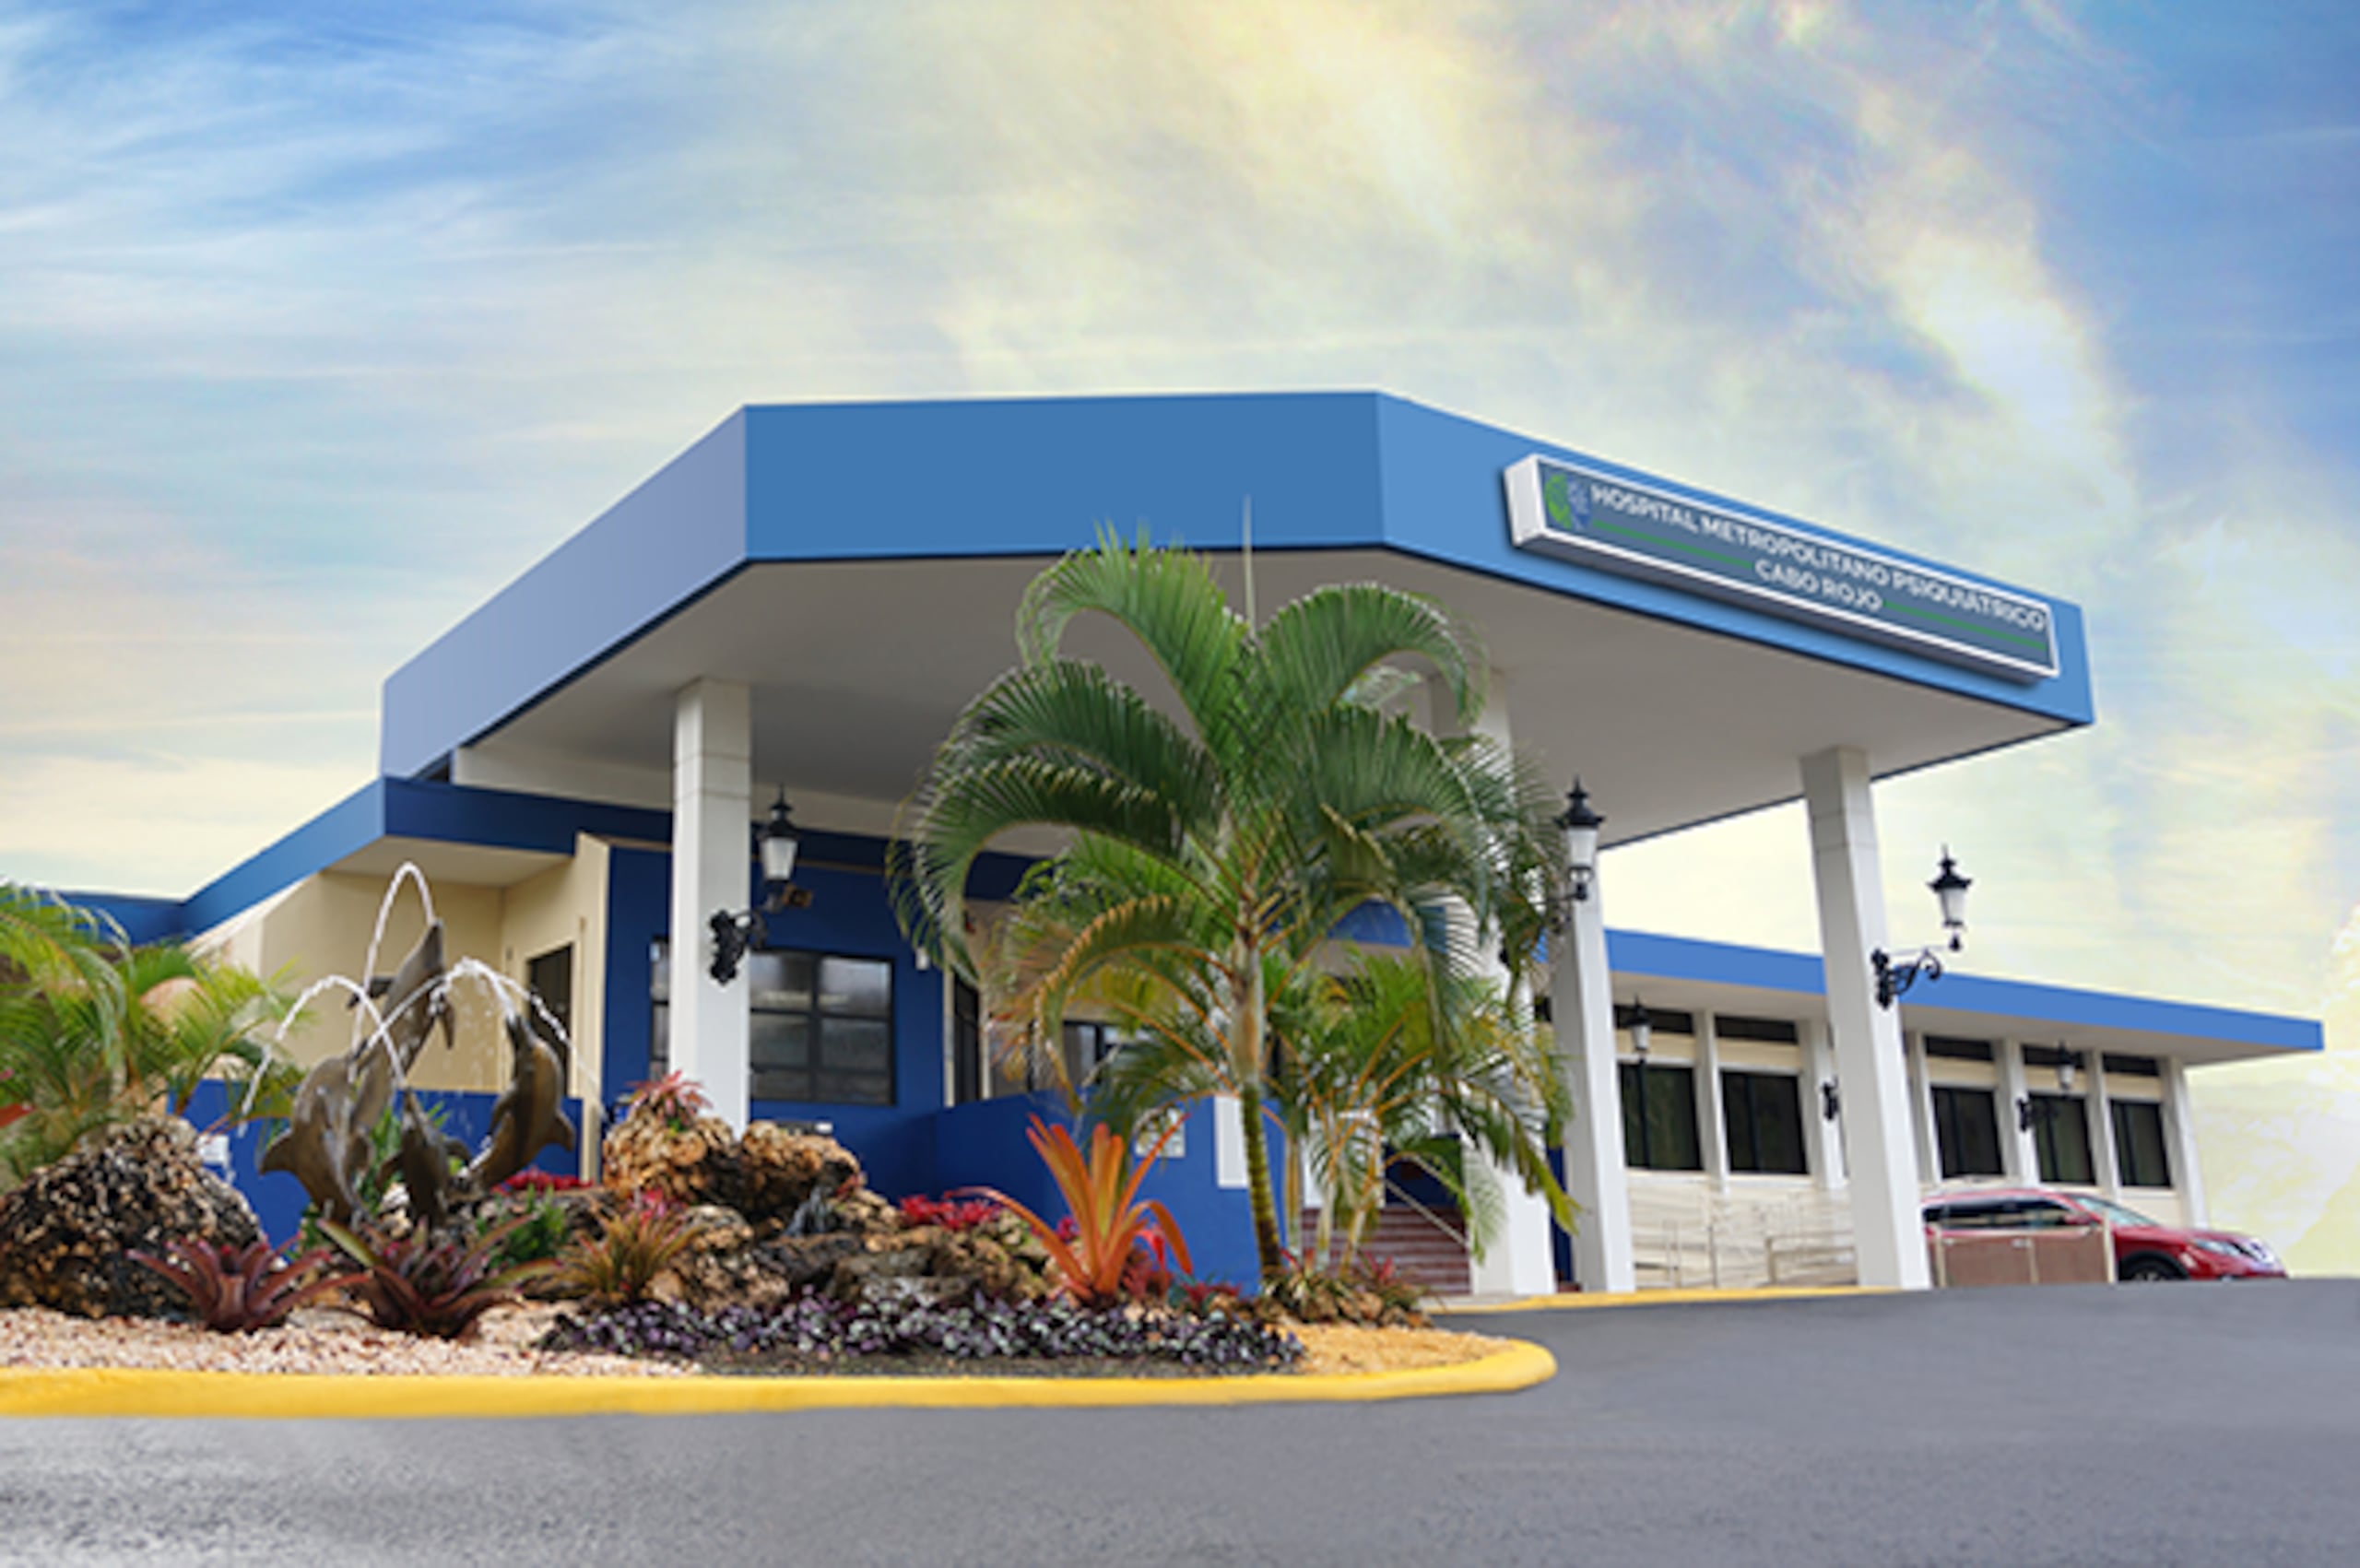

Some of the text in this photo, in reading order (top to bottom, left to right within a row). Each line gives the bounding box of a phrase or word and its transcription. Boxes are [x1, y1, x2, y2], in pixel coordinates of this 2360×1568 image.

[1590, 484, 1699, 533] HOSPITAL
[1701, 516, 1890, 586] METROPOLITANO
[1754, 559, 1882, 612] CABO ROJO
